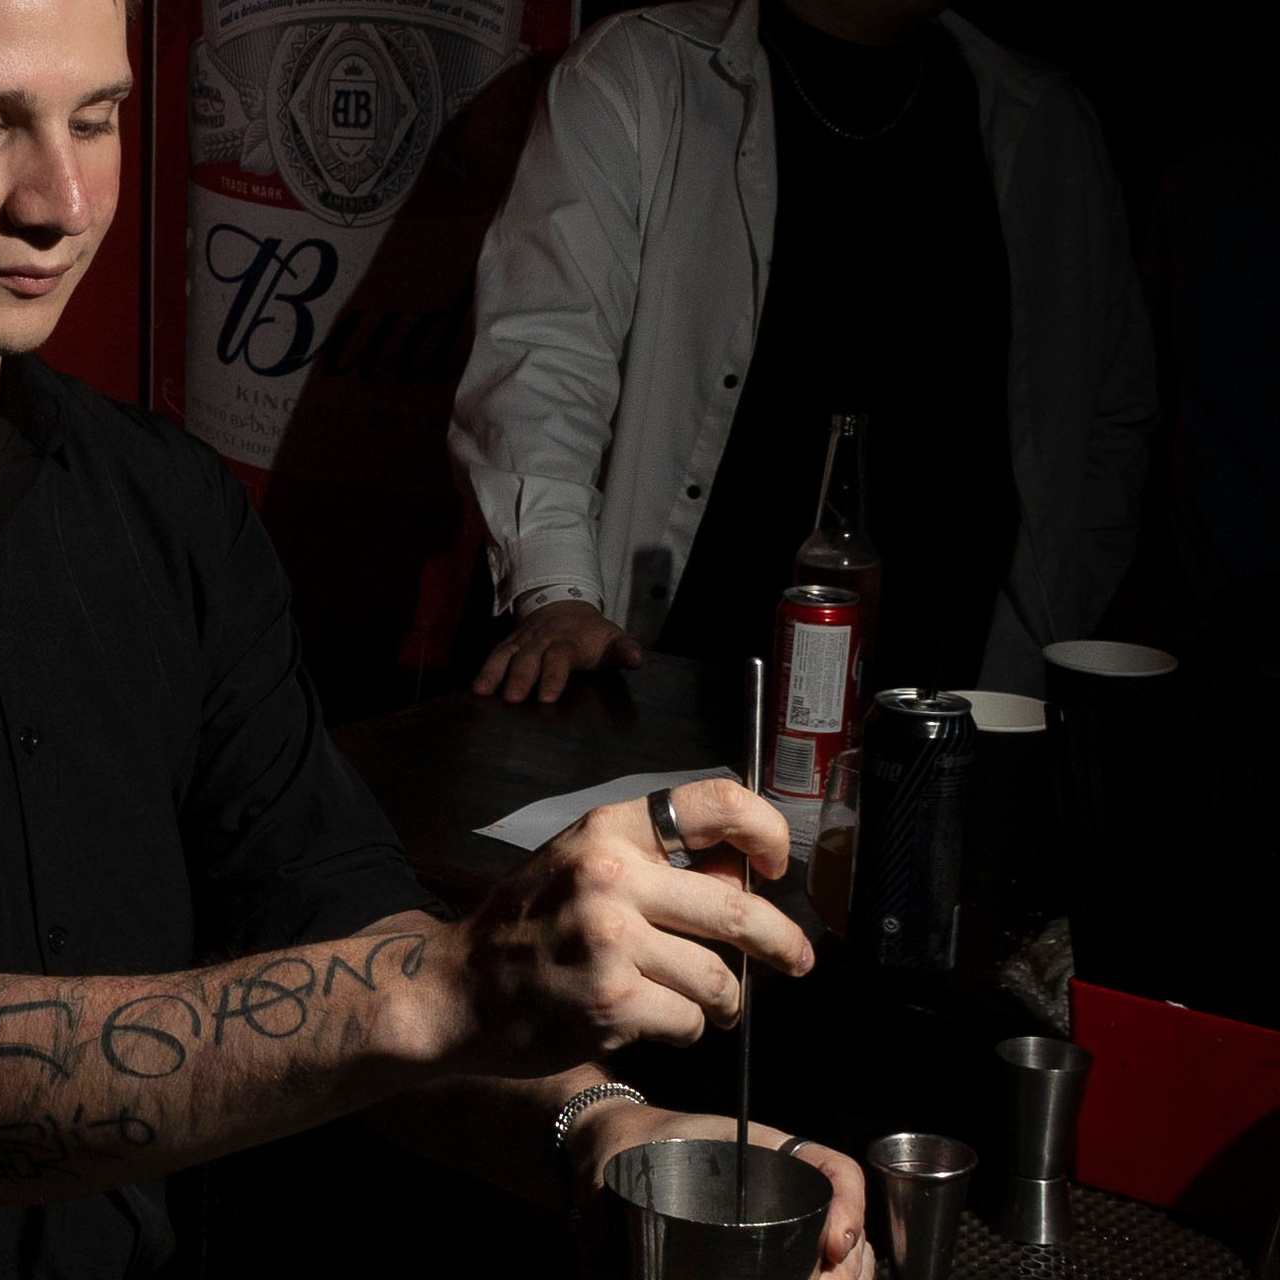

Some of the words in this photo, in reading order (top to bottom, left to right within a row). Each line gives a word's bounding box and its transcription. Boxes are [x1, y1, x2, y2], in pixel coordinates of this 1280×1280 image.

[429, 0, 450, 14] beer
[451, 5, 463, 16] at
[332, 88, 373, 130] AB
[220, 175, 249, 195] TRADE
[251, 183, 283, 202] MARK
[206, 223, 476, 382] Bud
